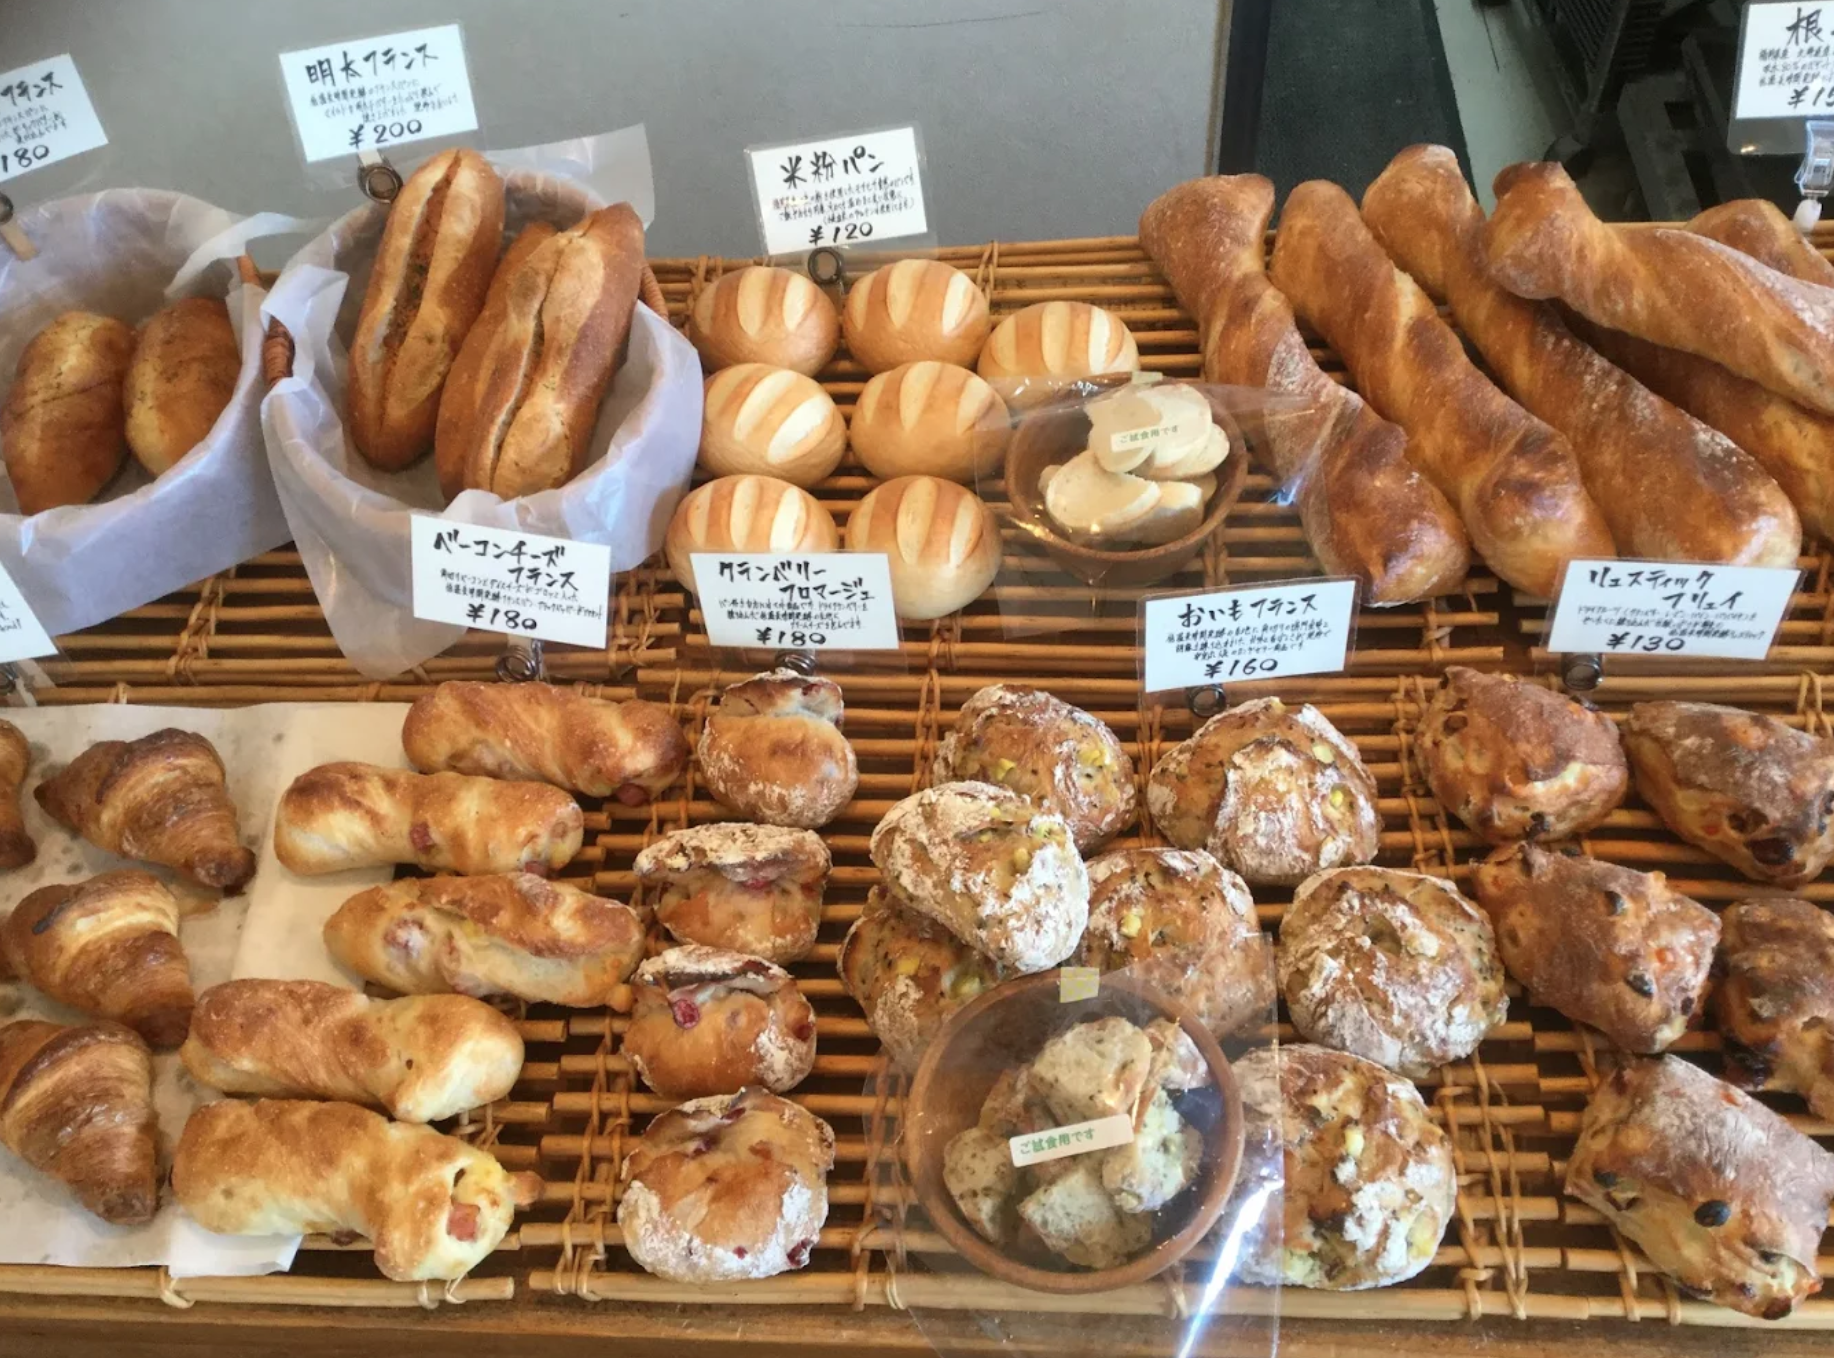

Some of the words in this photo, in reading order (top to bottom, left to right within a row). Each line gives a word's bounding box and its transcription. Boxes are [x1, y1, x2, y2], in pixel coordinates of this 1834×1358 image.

[304, 42, 439, 86] 明太フランス
[348, 119, 424, 148] ¥200
[1, 144, 50, 173] 180
[780, 145, 885, 190] 米粉パン
[808, 221, 874, 246] ¥120
[1119, 424, 1179, 443] ご試食用です
[433, 529, 566, 567] ベーコンチーズ
[507, 567, 580, 592] フランス
[719, 560, 828, 583] クランベリー
[1590, 566, 1715, 590] リュスティック
[778, 577, 876, 602] フロマージュ
[1661, 590, 1745, 611] フリュイ
[466, 603, 538, 630] ¥180
[1177, 593, 1319, 629] おいもフランス
[754, 626, 828, 647] ¥180
[1605, 631, 1686, 653] ¥130
[1203, 657, 1280, 680] ¥160
[1019, 1127, 1095, 1155] ご試食用です
